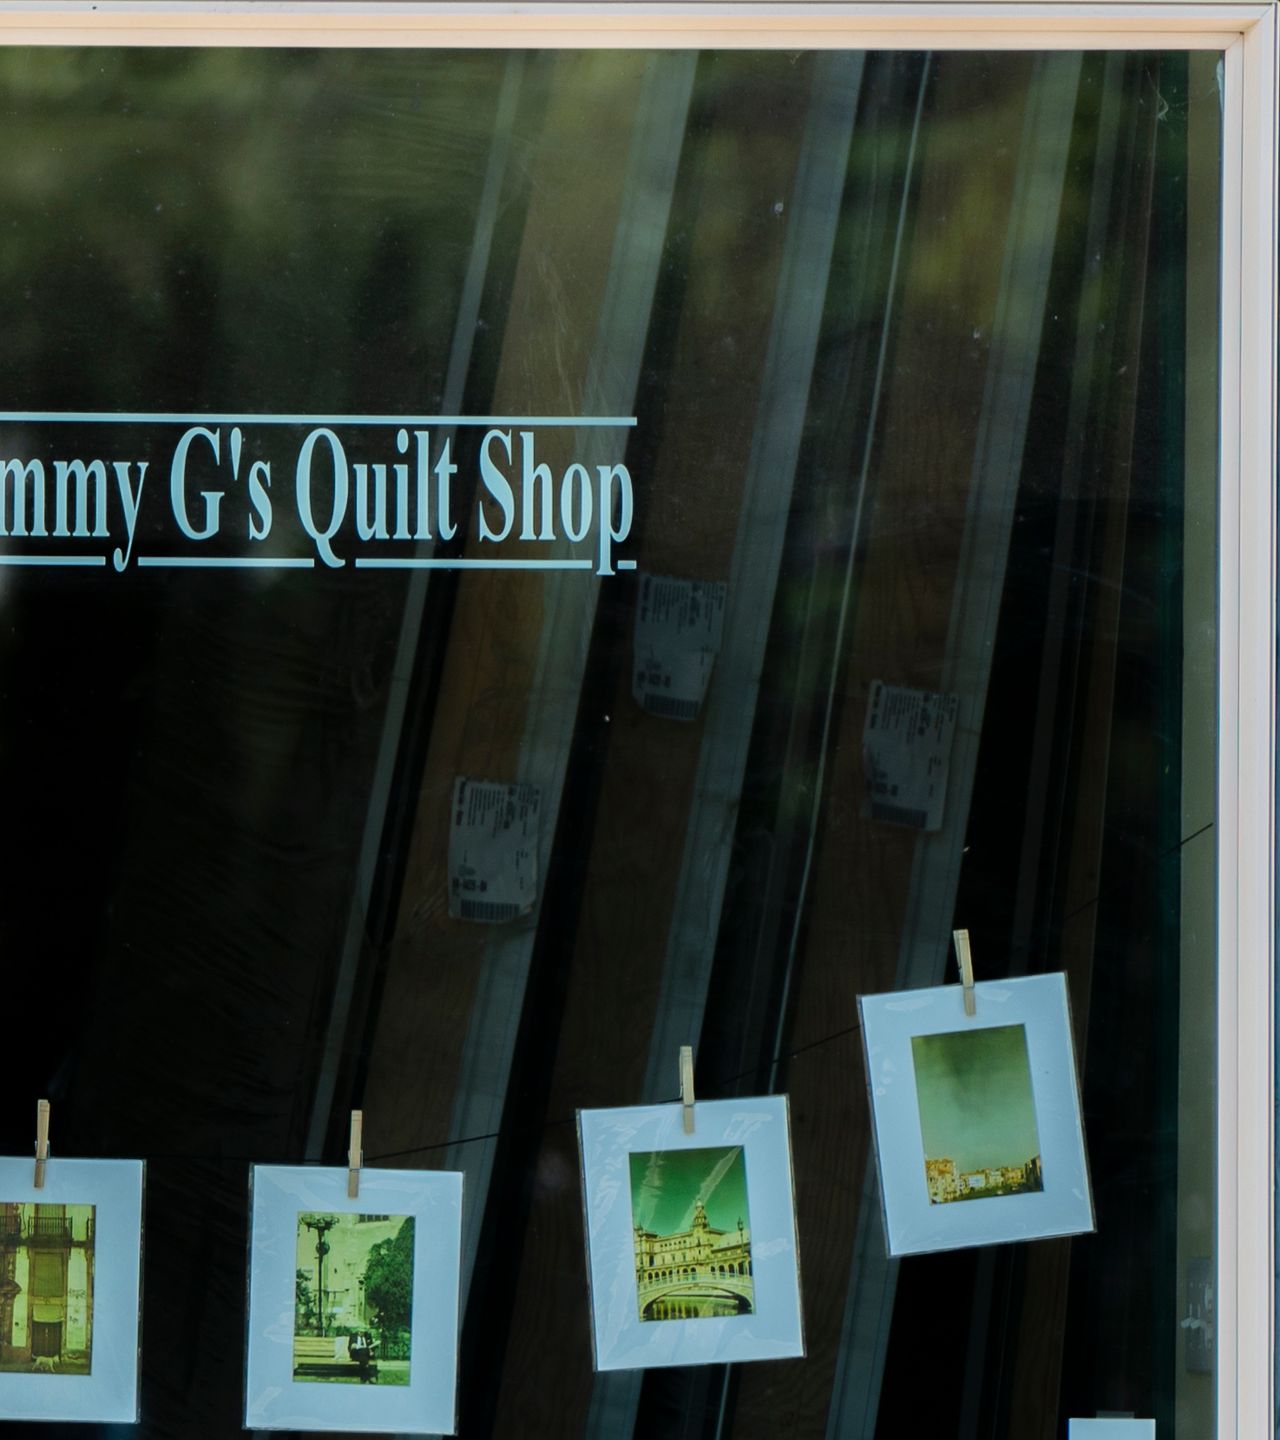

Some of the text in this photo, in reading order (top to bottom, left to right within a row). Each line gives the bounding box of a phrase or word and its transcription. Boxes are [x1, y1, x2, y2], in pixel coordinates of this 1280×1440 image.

[170, 426, 273, 541] G's
[295, 427, 458, 569] Quilt
[478, 429, 635, 576] Shop
